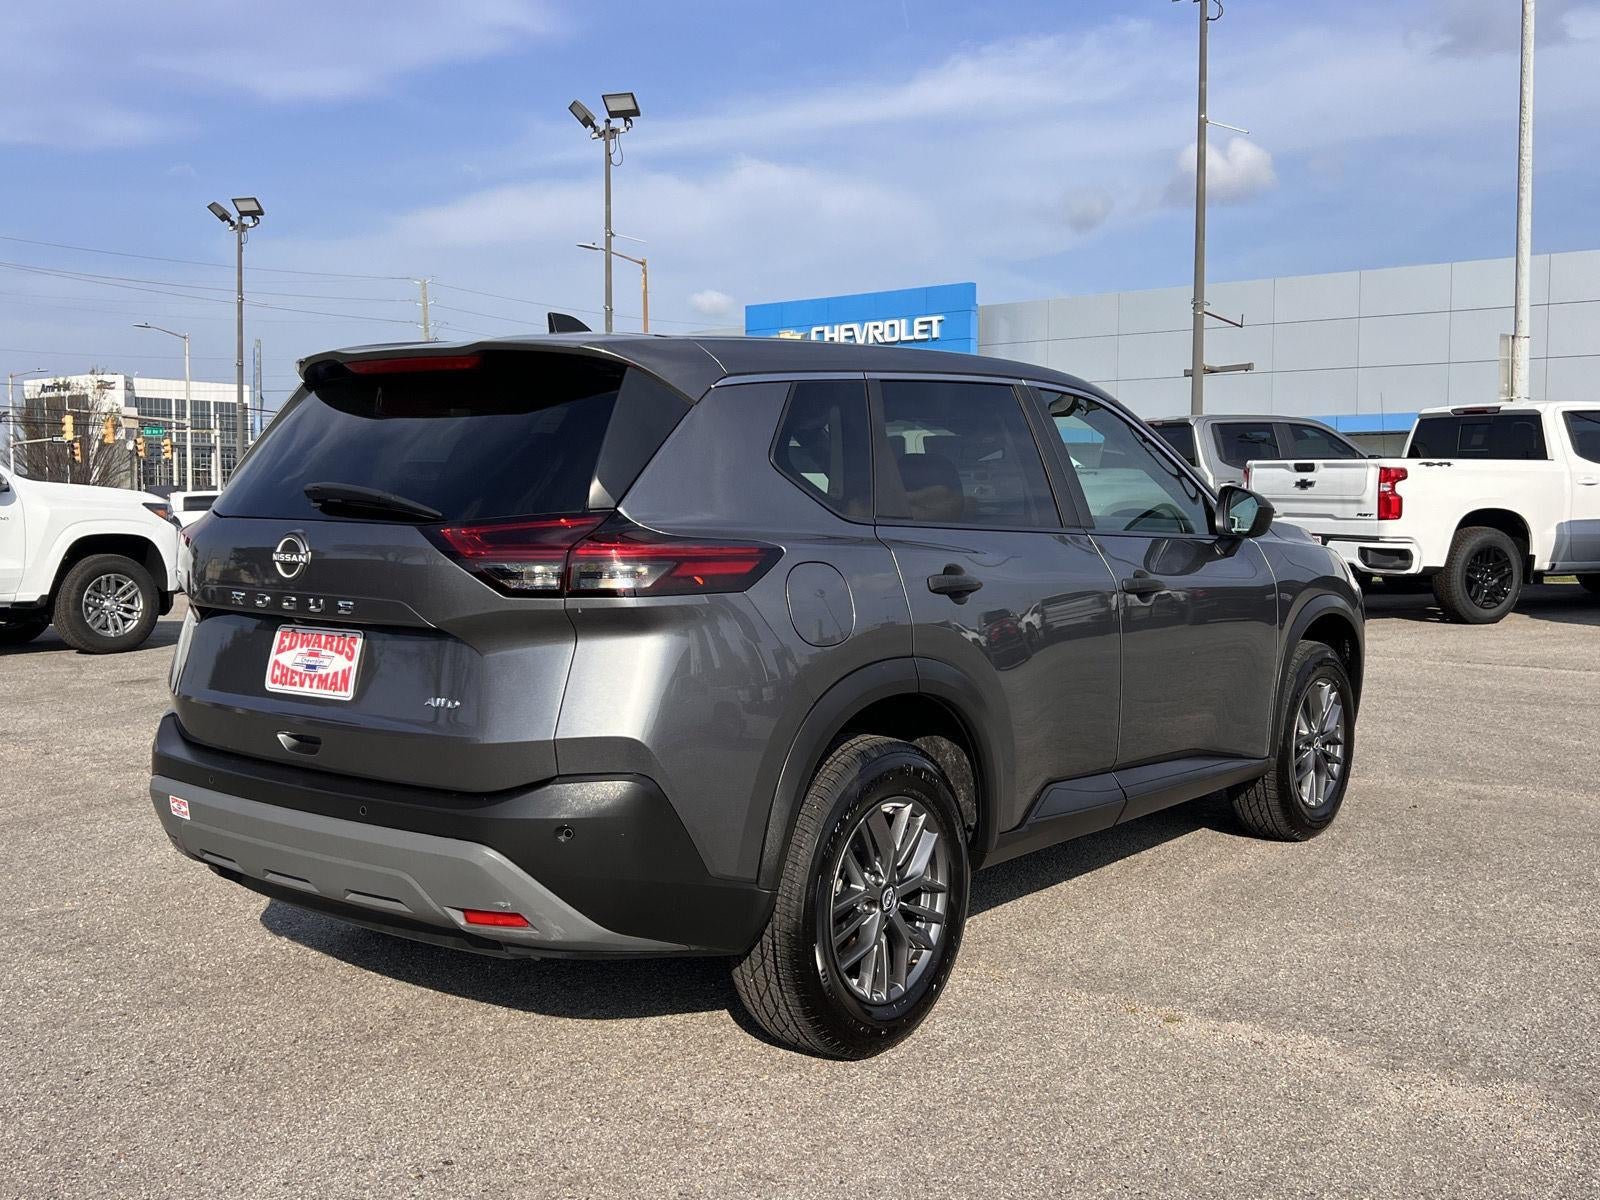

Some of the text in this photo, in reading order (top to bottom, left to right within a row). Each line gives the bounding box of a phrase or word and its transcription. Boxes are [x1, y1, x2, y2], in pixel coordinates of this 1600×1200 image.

[810, 315, 944, 345] CHEVROLET
[272, 553, 307, 563] NISSAN
[231, 591, 354, 615] ROGUE
[275, 631, 358, 662] EDWARDS
[270, 659, 353, 693] CHEVYMAN
